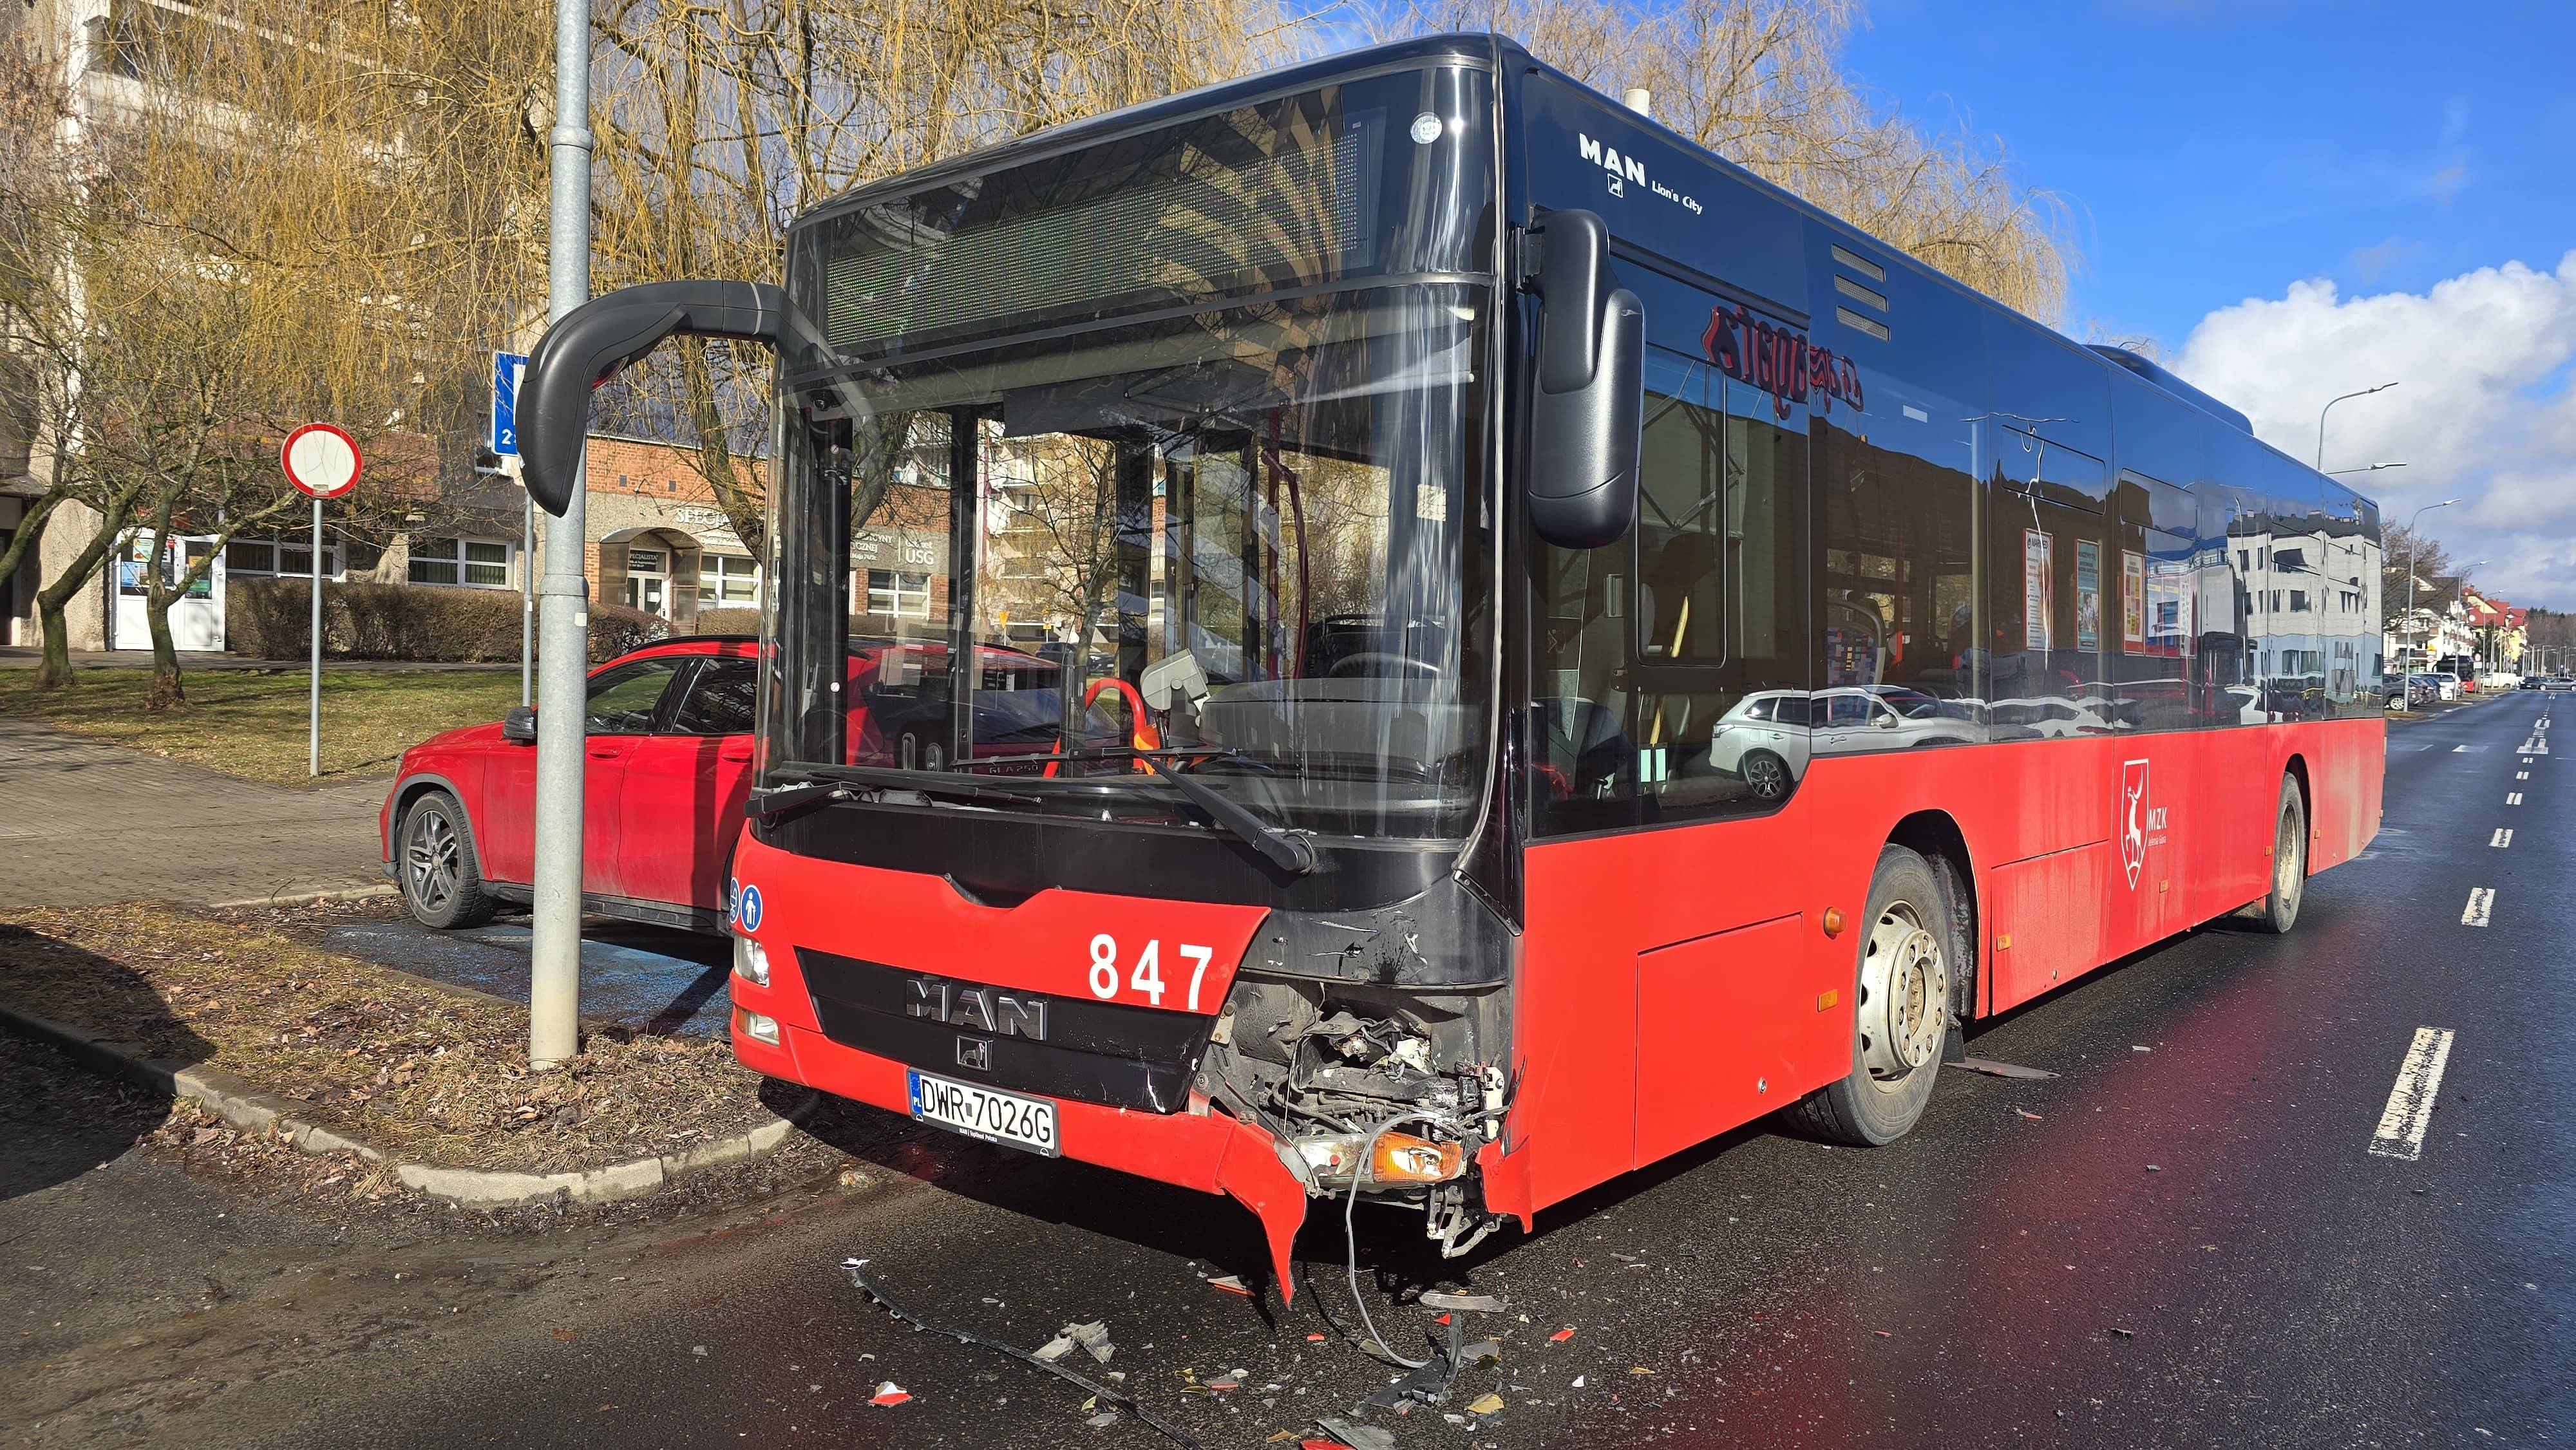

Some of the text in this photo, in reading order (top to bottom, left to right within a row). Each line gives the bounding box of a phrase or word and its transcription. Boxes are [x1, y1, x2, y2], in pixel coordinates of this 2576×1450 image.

[1579, 133, 1646, 187] MAN
[1652, 180, 1703, 215] Lion's City
[905, 549, 934, 565] USG
[2148, 807, 2167, 832] MZK
[1089, 934, 1213, 1011] 847
[906, 979, 1048, 1041] MAN
[913, 1096, 922, 1107] PL
